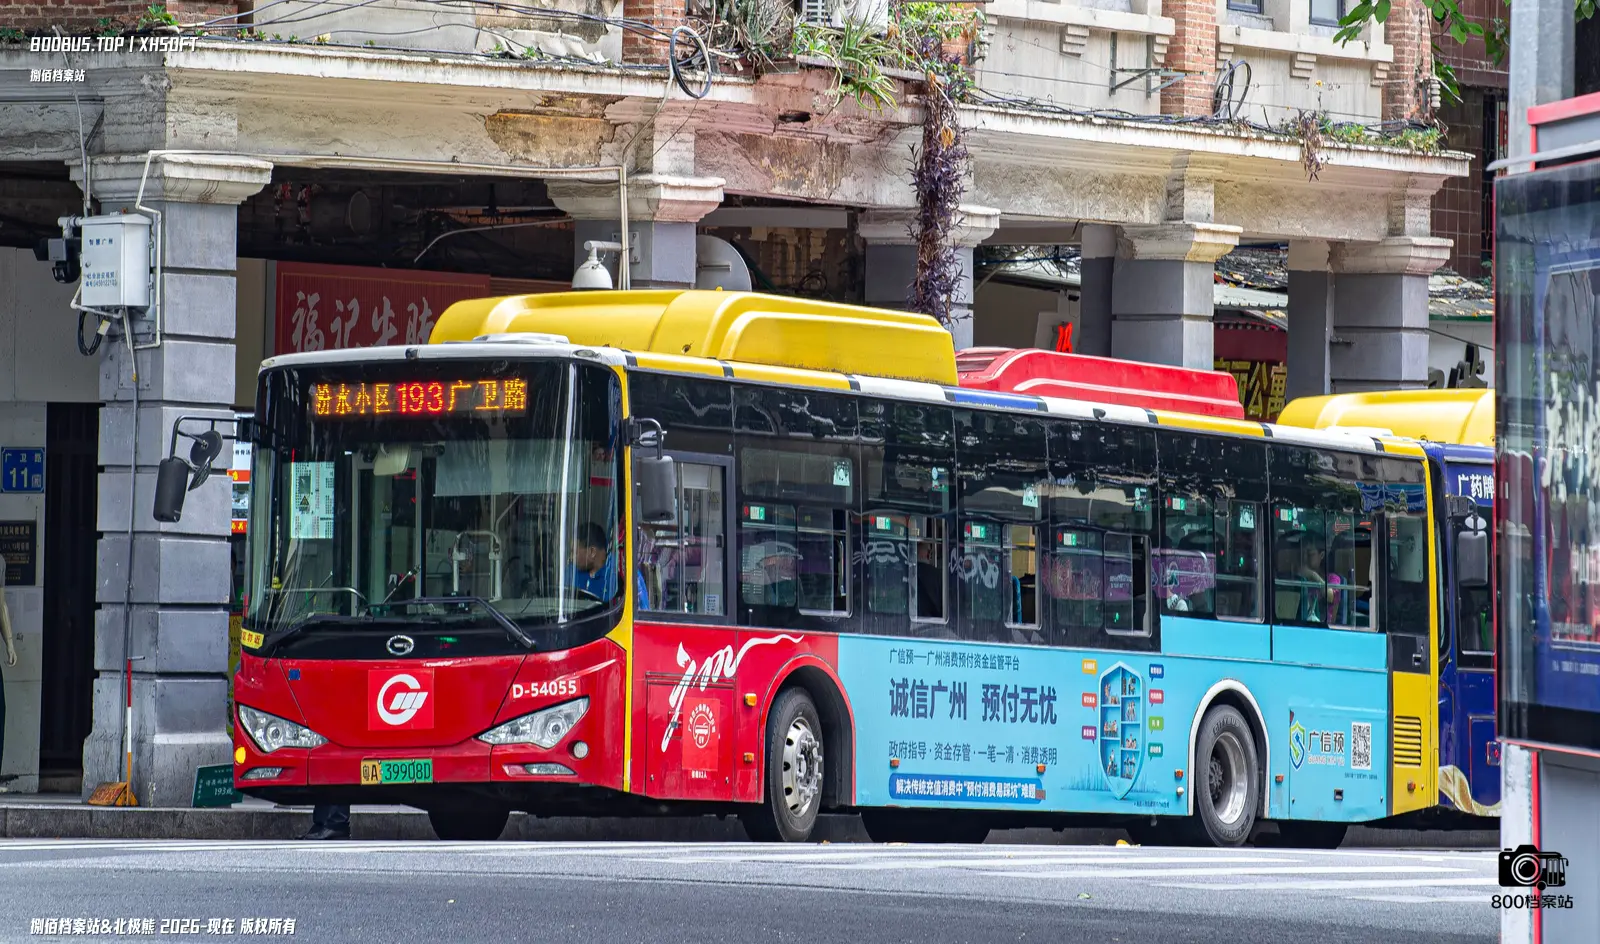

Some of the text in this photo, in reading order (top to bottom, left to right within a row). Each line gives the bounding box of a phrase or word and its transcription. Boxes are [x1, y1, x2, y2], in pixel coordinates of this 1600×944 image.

[398, 382, 443, 412] 193
[448, 378, 525, 411] 广卫路
[5, 453, 42, 463] 广卫路
[9, 467, 28, 488] 11
[512, 680, 577, 699] D-54055
[889, 678, 1057, 724] 诚信广州 预付无忧
[1308, 731, 1344, 753] 广信预
